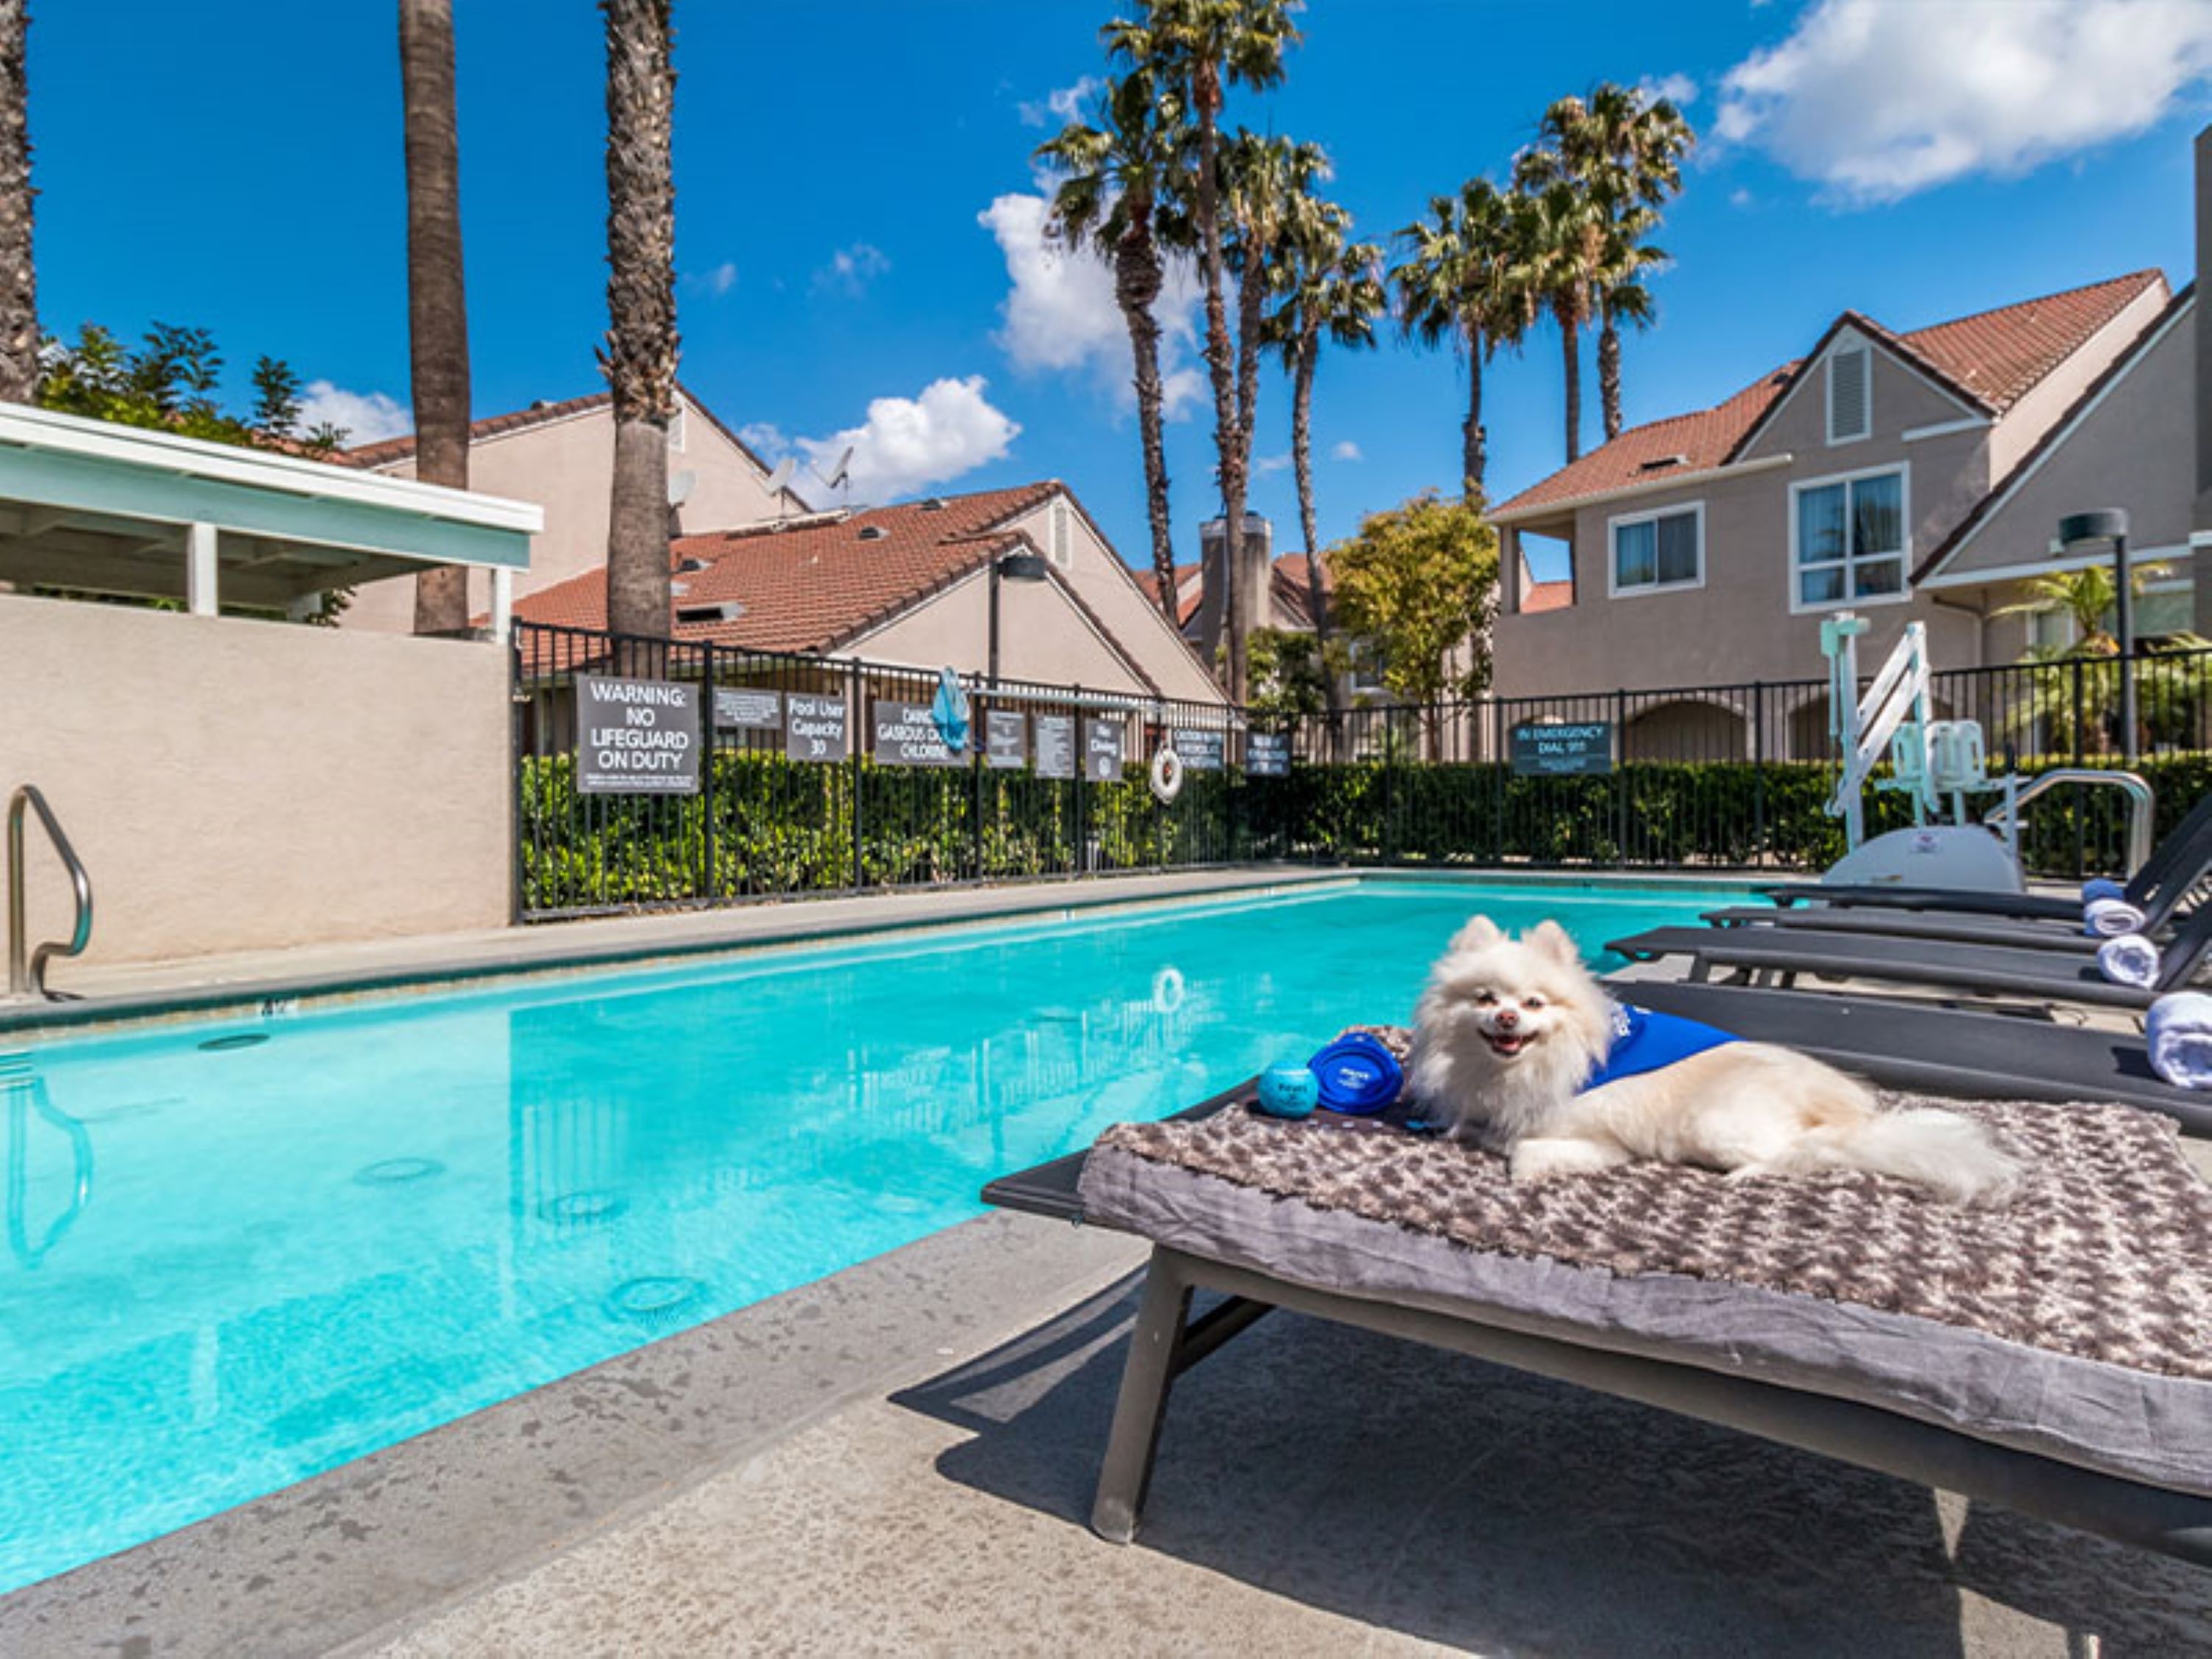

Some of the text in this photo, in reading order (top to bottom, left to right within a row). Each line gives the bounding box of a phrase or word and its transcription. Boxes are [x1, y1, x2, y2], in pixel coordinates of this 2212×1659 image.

[626, 706, 655, 726] NO
[790, 698, 815, 716] Pool
[820, 700, 845, 718] User
[591, 728, 689, 749] LIFEGUARD
[792, 717, 843, 741] Capacity
[1539, 741, 1565, 754] DIAL
[598, 750, 683, 770] ON DUTY
